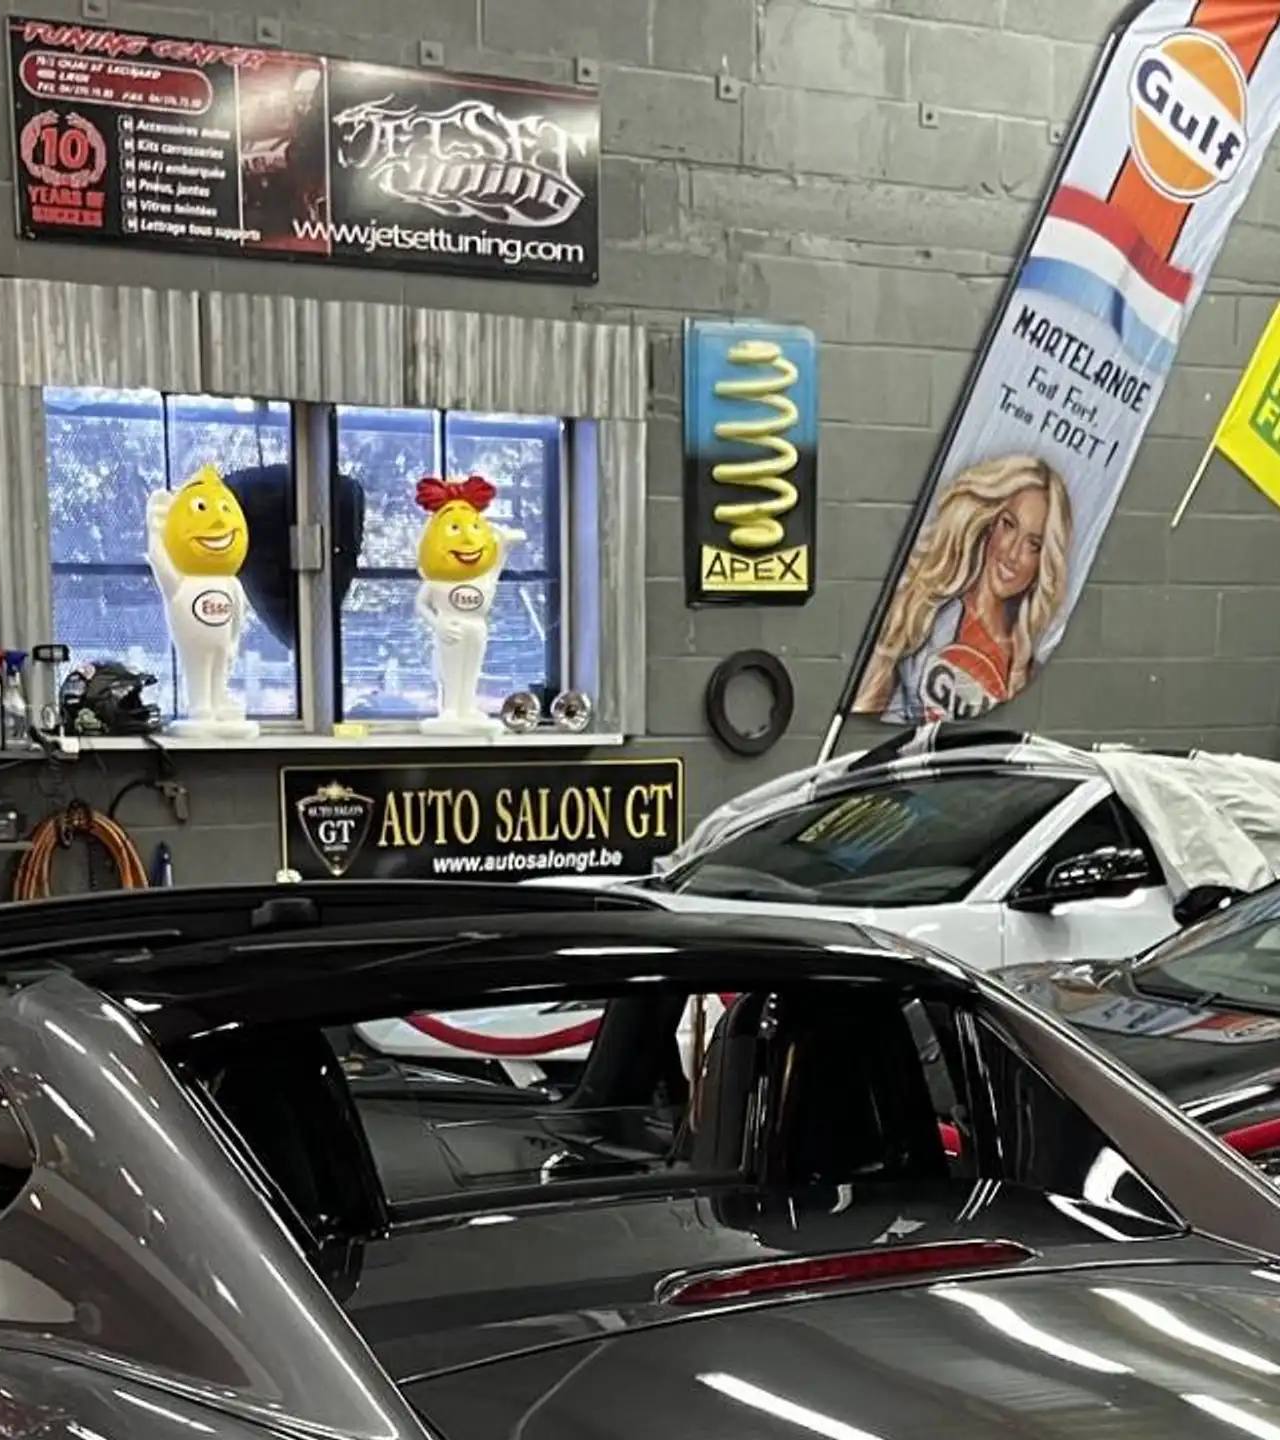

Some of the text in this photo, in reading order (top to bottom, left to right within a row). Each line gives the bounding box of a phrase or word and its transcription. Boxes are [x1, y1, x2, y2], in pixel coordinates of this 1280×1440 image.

[1137, 58, 1241, 171] Gulf
[40, 127, 89, 170] 10
[292, 218, 584, 264] www.jetsettuning.com
[1039, 409, 1106, 460] FORT
[704, 550, 804, 581] APEX
[318, 819, 356, 844] GT
[377, 782, 673, 848] AUTO SALON GT
[432, 846, 623, 875] www.autosalongt.be
